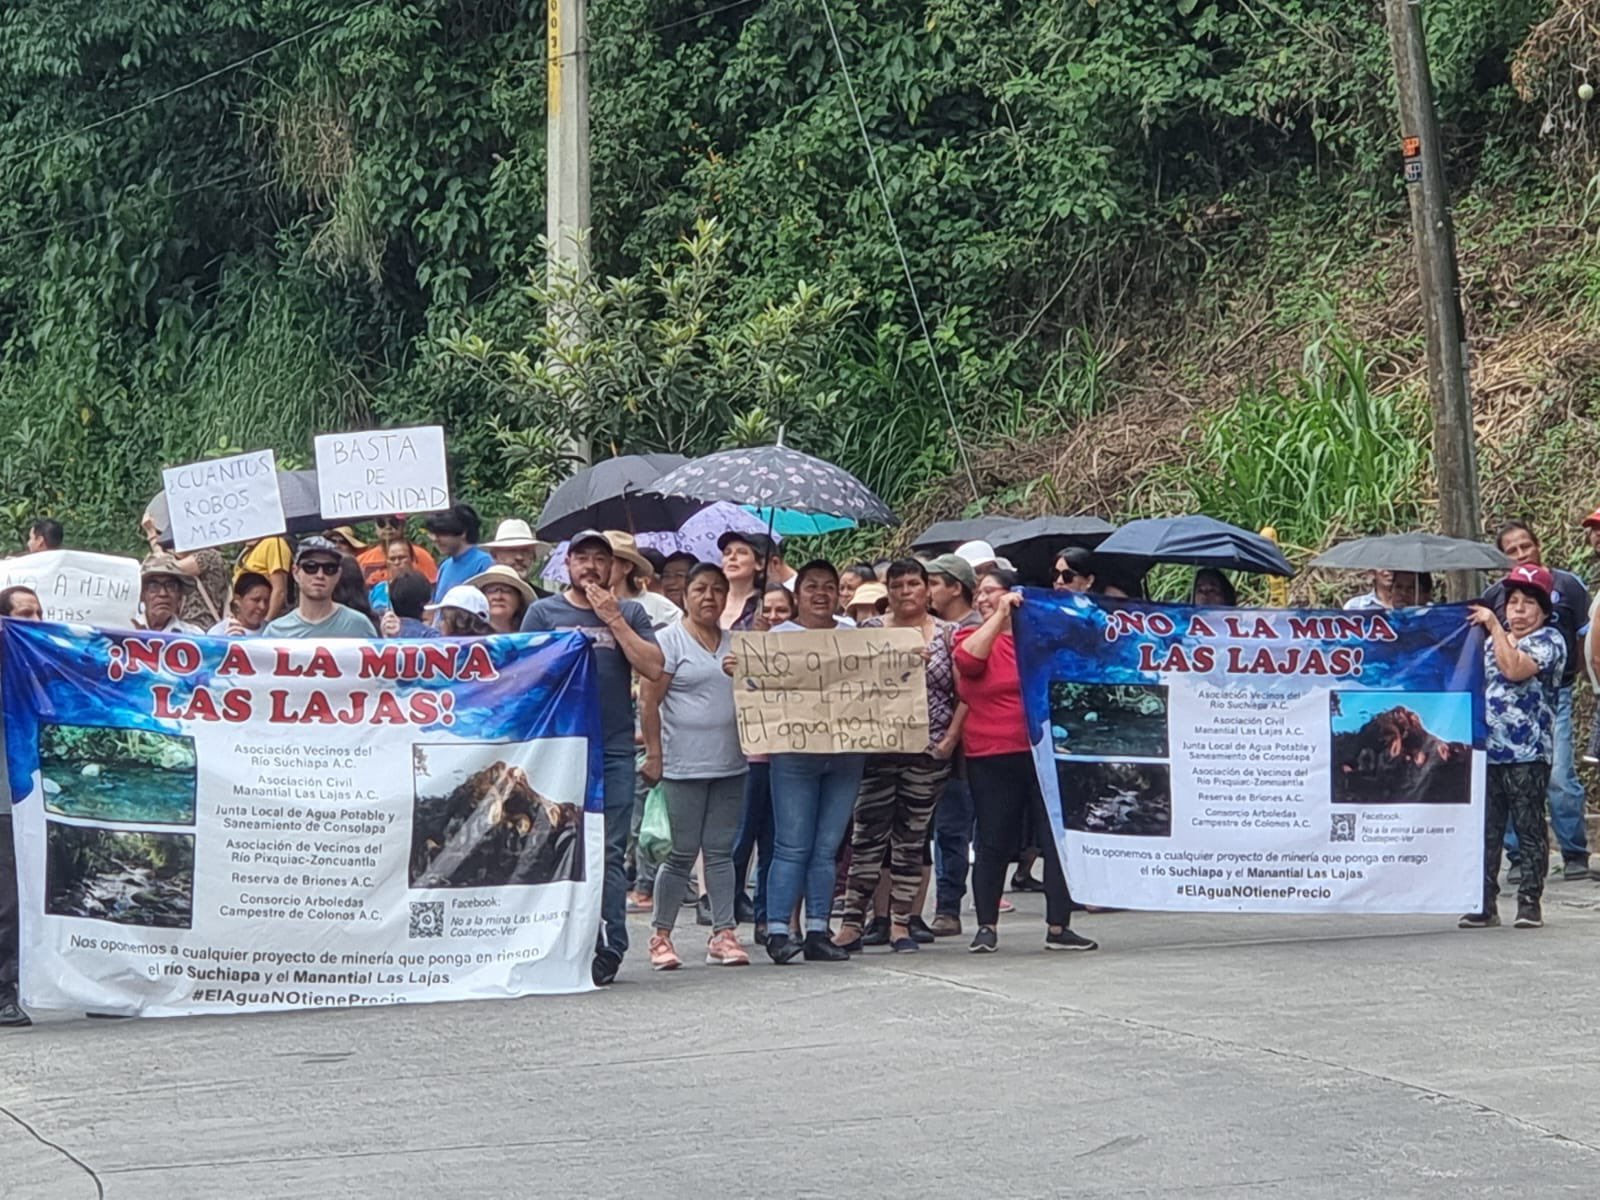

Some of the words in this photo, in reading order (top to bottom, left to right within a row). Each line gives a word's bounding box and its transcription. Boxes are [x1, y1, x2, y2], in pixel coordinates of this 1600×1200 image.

[333, 435, 417, 465] BASTA
[366, 468, 384, 485] DE
[185, 489, 250, 518] ROBOS
[332, 487, 447, 513] IMPUNIDAD
[54, 574, 67, 596] A
[80, 576, 131, 600] MINA
[1105, 610, 1175, 641] ¡NO
[1187, 615, 1216, 639] A
[1224, 616, 1279, 640] LA
[1288, 614, 1399, 642] MINA
[107, 638, 202, 682] ¡NO
[216, 643, 257, 678] A
[272, 645, 343, 680] LA
[357, 642, 499, 682] MINA
[741, 635, 791, 674] No
[806, 652, 821, 672] a
[833, 635, 859, 673] la
[1138, 643, 1215, 673] LAS
[1226, 646, 1363, 677] LAJAS!
[151, 684, 253, 723] LAS
[269, 688, 456, 727] LAJAS!
[777, 721, 829, 750] agua
[234, 743, 300, 756] Asociación
[303, 745, 350, 757] Vecinos
[353, 746, 372, 757] del
[251, 756, 270, 767] Río
[274, 758, 329, 770] Suchiapa
[333, 758, 356, 769] A.C.
[258, 775, 323, 787] Asociación
[327, 777, 352, 788] Civil
[233, 785, 291, 798] Manantial
[295, 788, 316, 799] Las
[320, 788, 351, 801] Lajas
[355, 790, 379, 800] A.C.
[215, 804, 248, 816] Junta
[252, 806, 284, 817] Local
[287, 807, 302, 818] de
[306, 808, 336, 821] Agua
[340, 809, 385, 821] Potable
[387, 812, 396, 824] y
[223, 817, 302, 831] Saneamiento
[306, 819, 319, 832] de
[323, 820, 386, 835] Consolapa
[226, 839, 292, 852] Asociación
[296, 840, 310, 852] de
[314, 842, 361, 853] Vecinos
[364, 843, 382, 854] del
[231, 851, 250, 863] Río
[254, 853, 376, 868] Pixquiac-Zoncuantla
[1155, 852, 1161, 860] a
[1266, 852, 1279, 862] de
[1322, 855, 1342, 865] que
[1345, 855, 1379, 865] ponga
[232, 872, 279, 884] Reserva
[284, 874, 298, 885] de
[302, 875, 347, 887] Briones
[351, 877, 375, 888] A.C.
[1140, 866, 1149, 875] el
[1169, 866, 1223, 879] Suchiapa
[1226, 869, 1232, 880] y
[1235, 868, 1243, 878] el
[1247, 866, 1304, 878] Manantial
[1307, 868, 1327, 878] Las
[1331, 868, 1363, 881] Lajas
[239, 893, 300, 906] Consorcio
[304, 895, 364, 908] Arboledas
[1176, 885, 1332, 900] #ElAguaNOtienePrecio
[219, 905, 285, 919] Campestre
[289, 907, 303, 919] de
[307, 908, 355, 921] Colonos
[359, 910, 383, 921] A.C.
[514, 913, 530, 924] Las
[70, 934, 97, 949] Nos
[100, 938, 167, 955] oponemos
[170, 946, 178, 955] a
[182, 946, 247, 961] cualquier
[252, 949, 316, 965] proyecto
[320, 950, 337, 964] de
[341, 950, 393, 965] minería
[399, 953, 425, 968] que
[429, 952, 471, 968] ponga
[476, 952, 492, 963] en
[148, 962, 160, 975] el
[164, 961, 183, 975] río
[187, 965, 260, 983] Suchiapa
[264, 971, 273, 985] y
[276, 970, 289, 983] el
[293, 970, 372, 984] Manantial
[377, 971, 404, 984] Las
[409, 971, 450, 987] Lajas
